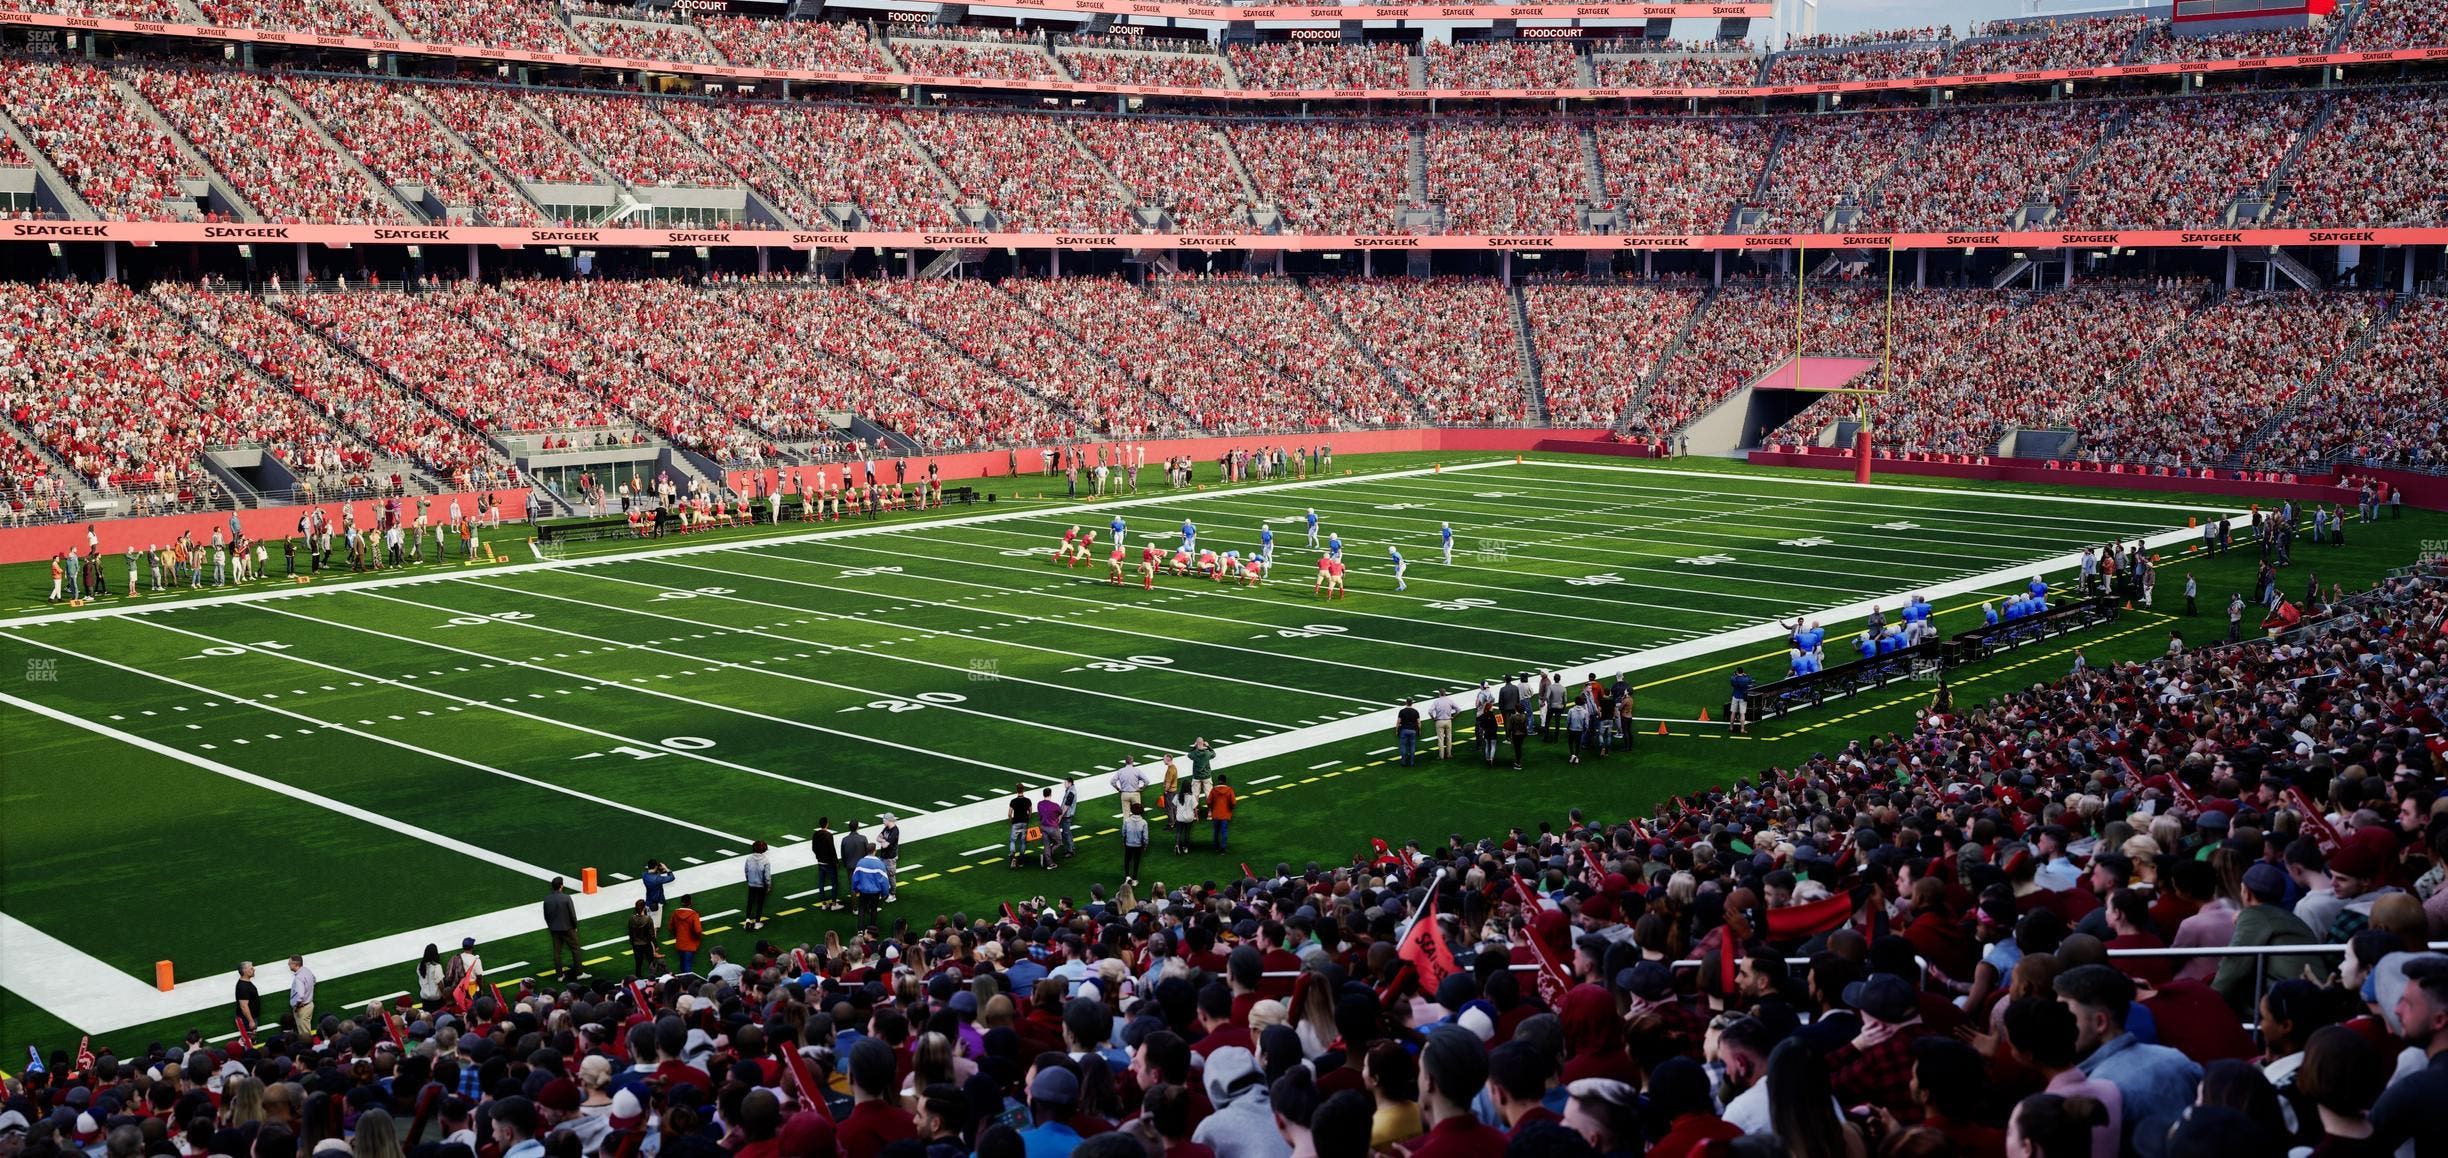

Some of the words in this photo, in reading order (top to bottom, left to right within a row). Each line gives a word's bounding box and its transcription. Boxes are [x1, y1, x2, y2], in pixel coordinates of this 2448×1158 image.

[1076, 1, 1104, 10] SEATGEEK
[1133, 4, 1160, 14] SEATGEEK
[1188, 8, 1215, 17] SEATGEEK
[1243, 9, 1275, 18] SEATGEEK
[1311, 9, 1343, 18] SEATGEEK
[1376, 8, 1408, 17] SEATGEEK
[1442, 8, 1474, 17] SEATGEEK
[1510, 8, 1543, 16] SEATGEEK
[1577, 8, 1609, 16] SEATGEEK
[1643, 7, 1674, 16] SEATGEEK
[1713, 7, 1745, 15] SEATGEEK
[1291, 30, 1341, 39] FOODCOU
[1523, 29, 1583, 38] FOODCOURT
[2426, 49, 2448, 57] SEATG
[14, 222, 109, 237] SEATGEEK
[205, 226, 289, 239] SEATGEEK
[374, 228, 450, 240] SEATGEEK
[532, 230, 600, 242] SEATGEEK
[669, 232, 730, 243] SEATGEEK
[793, 234, 848, 246] SEATGEEK
[924, 235, 988, 246] SEATGEEK
[1843, 236, 1893, 245] SEATGEEK
[1947, 235, 1999, 245] SEATGEEK
[2062, 233, 2119, 244] SEATGEEK
[2181, 232, 2242, 243] SEATGEEK
[2309, 230, 2374, 242] SEATGEEK
[1056, 236, 1117, 247] SEATGEEK
[1180, 236, 1237, 247] SEATGEEK
[1354, 238, 1419, 247] SEATGEEK
[1489, 238, 1553, 247] SEATGEEK
[1624, 238, 1689, 247] SEATGEEK
[1746, 237, 1792, 246] SEATGEEK
[1421, 598, 1497, 611] 50
[1276, 624, 1348, 638] 40
[1085, 655, 1174, 672] 30
[866, 692, 967, 713] 20
[608, 736, 717, 760] 10
